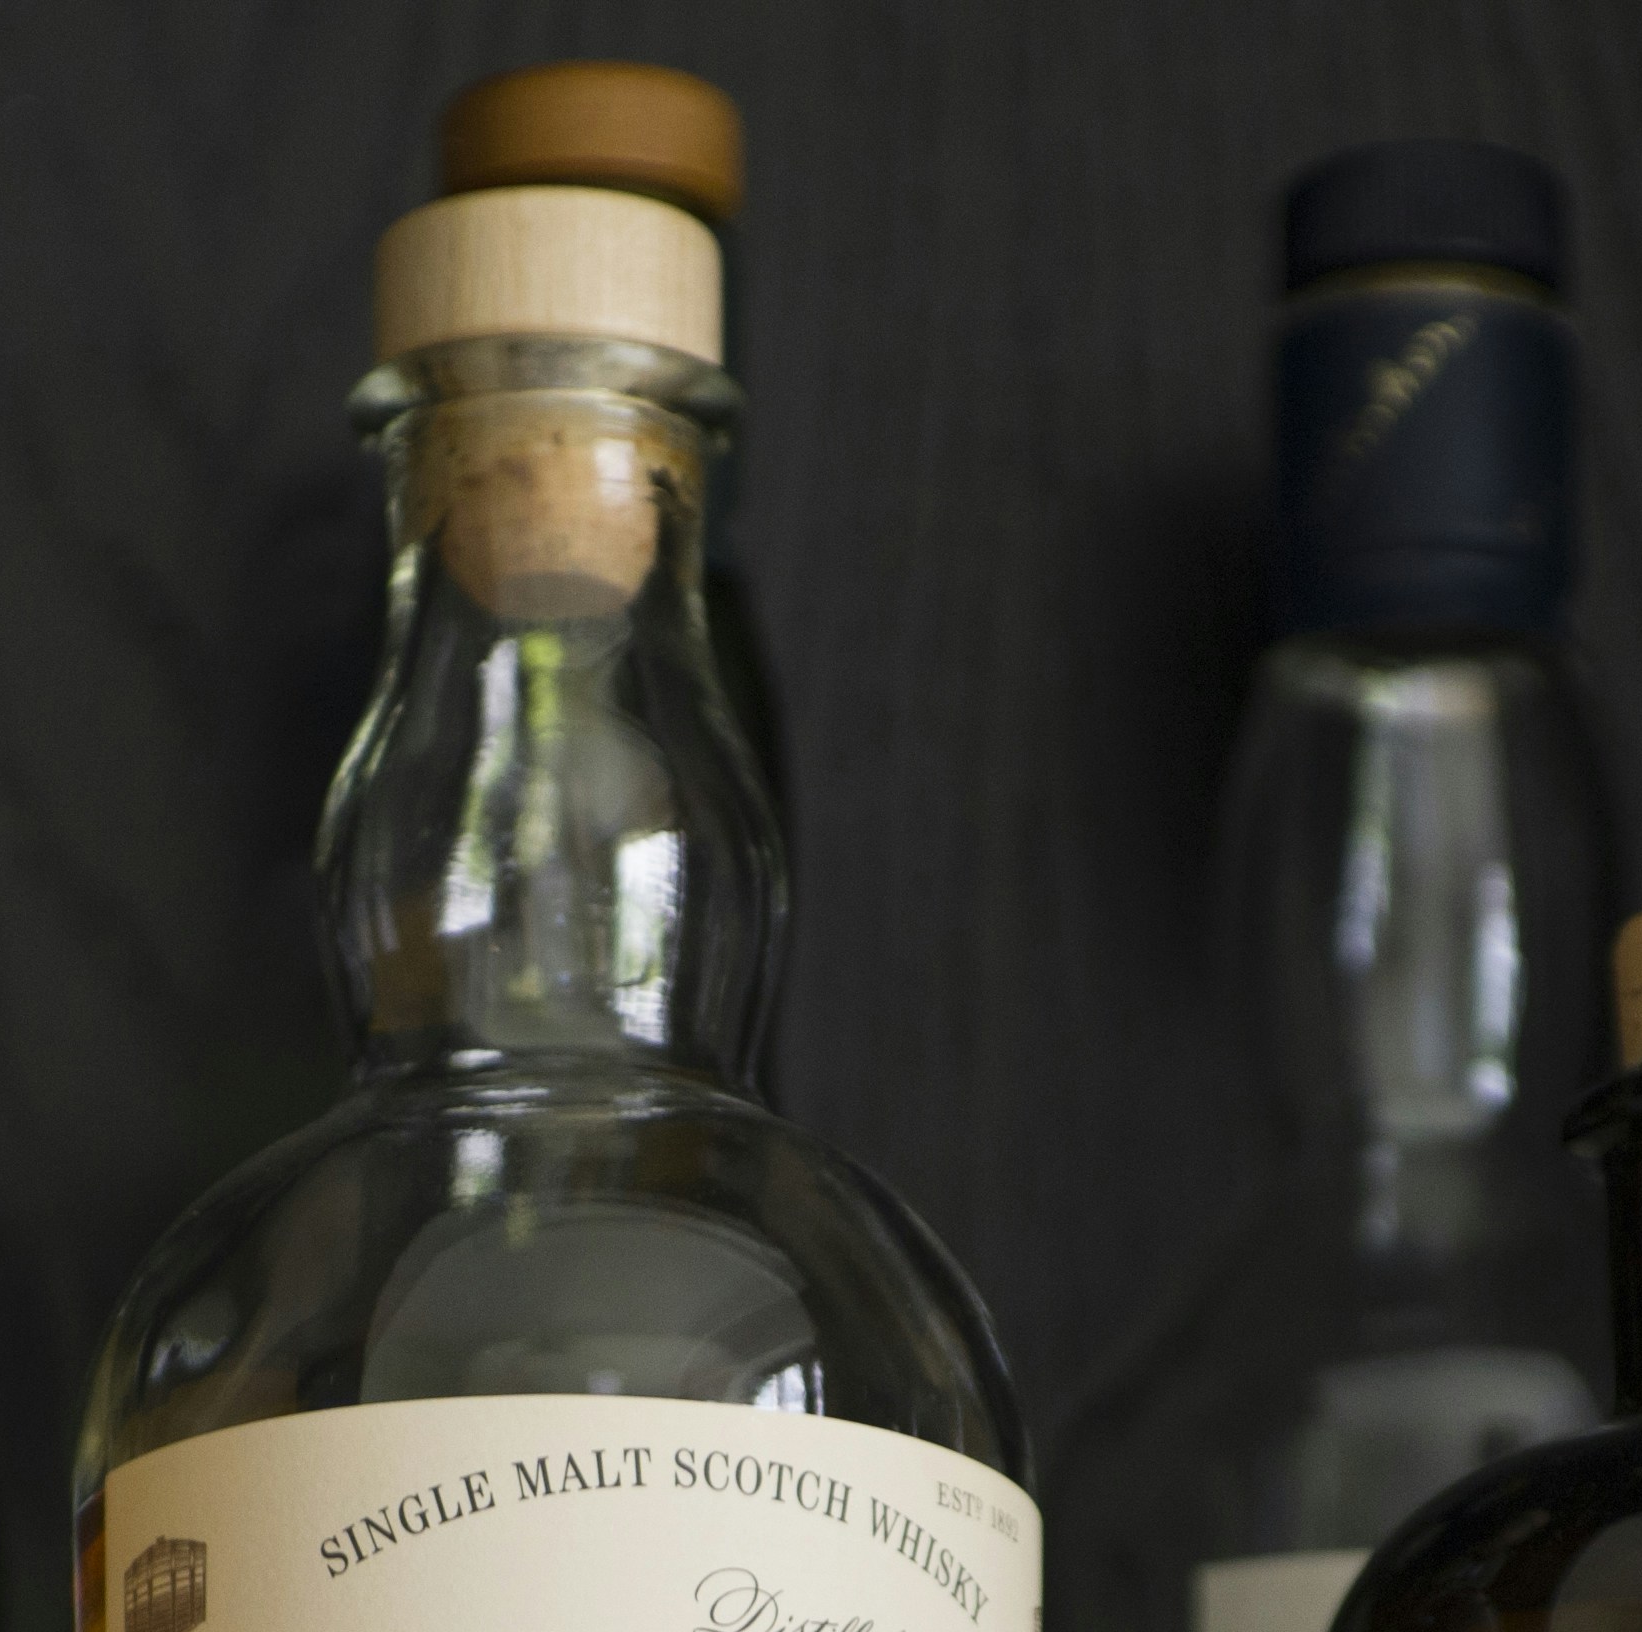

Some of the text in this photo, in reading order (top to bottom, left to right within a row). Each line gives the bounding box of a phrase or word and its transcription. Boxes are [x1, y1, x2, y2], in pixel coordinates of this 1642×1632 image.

[320, 1472, 495, 1579] SINGLE
[514, 1447, 652, 1500] MALT
[674, 1449, 852, 1523] SCOTCH
[868, 1498, 988, 1623] WHISKY
